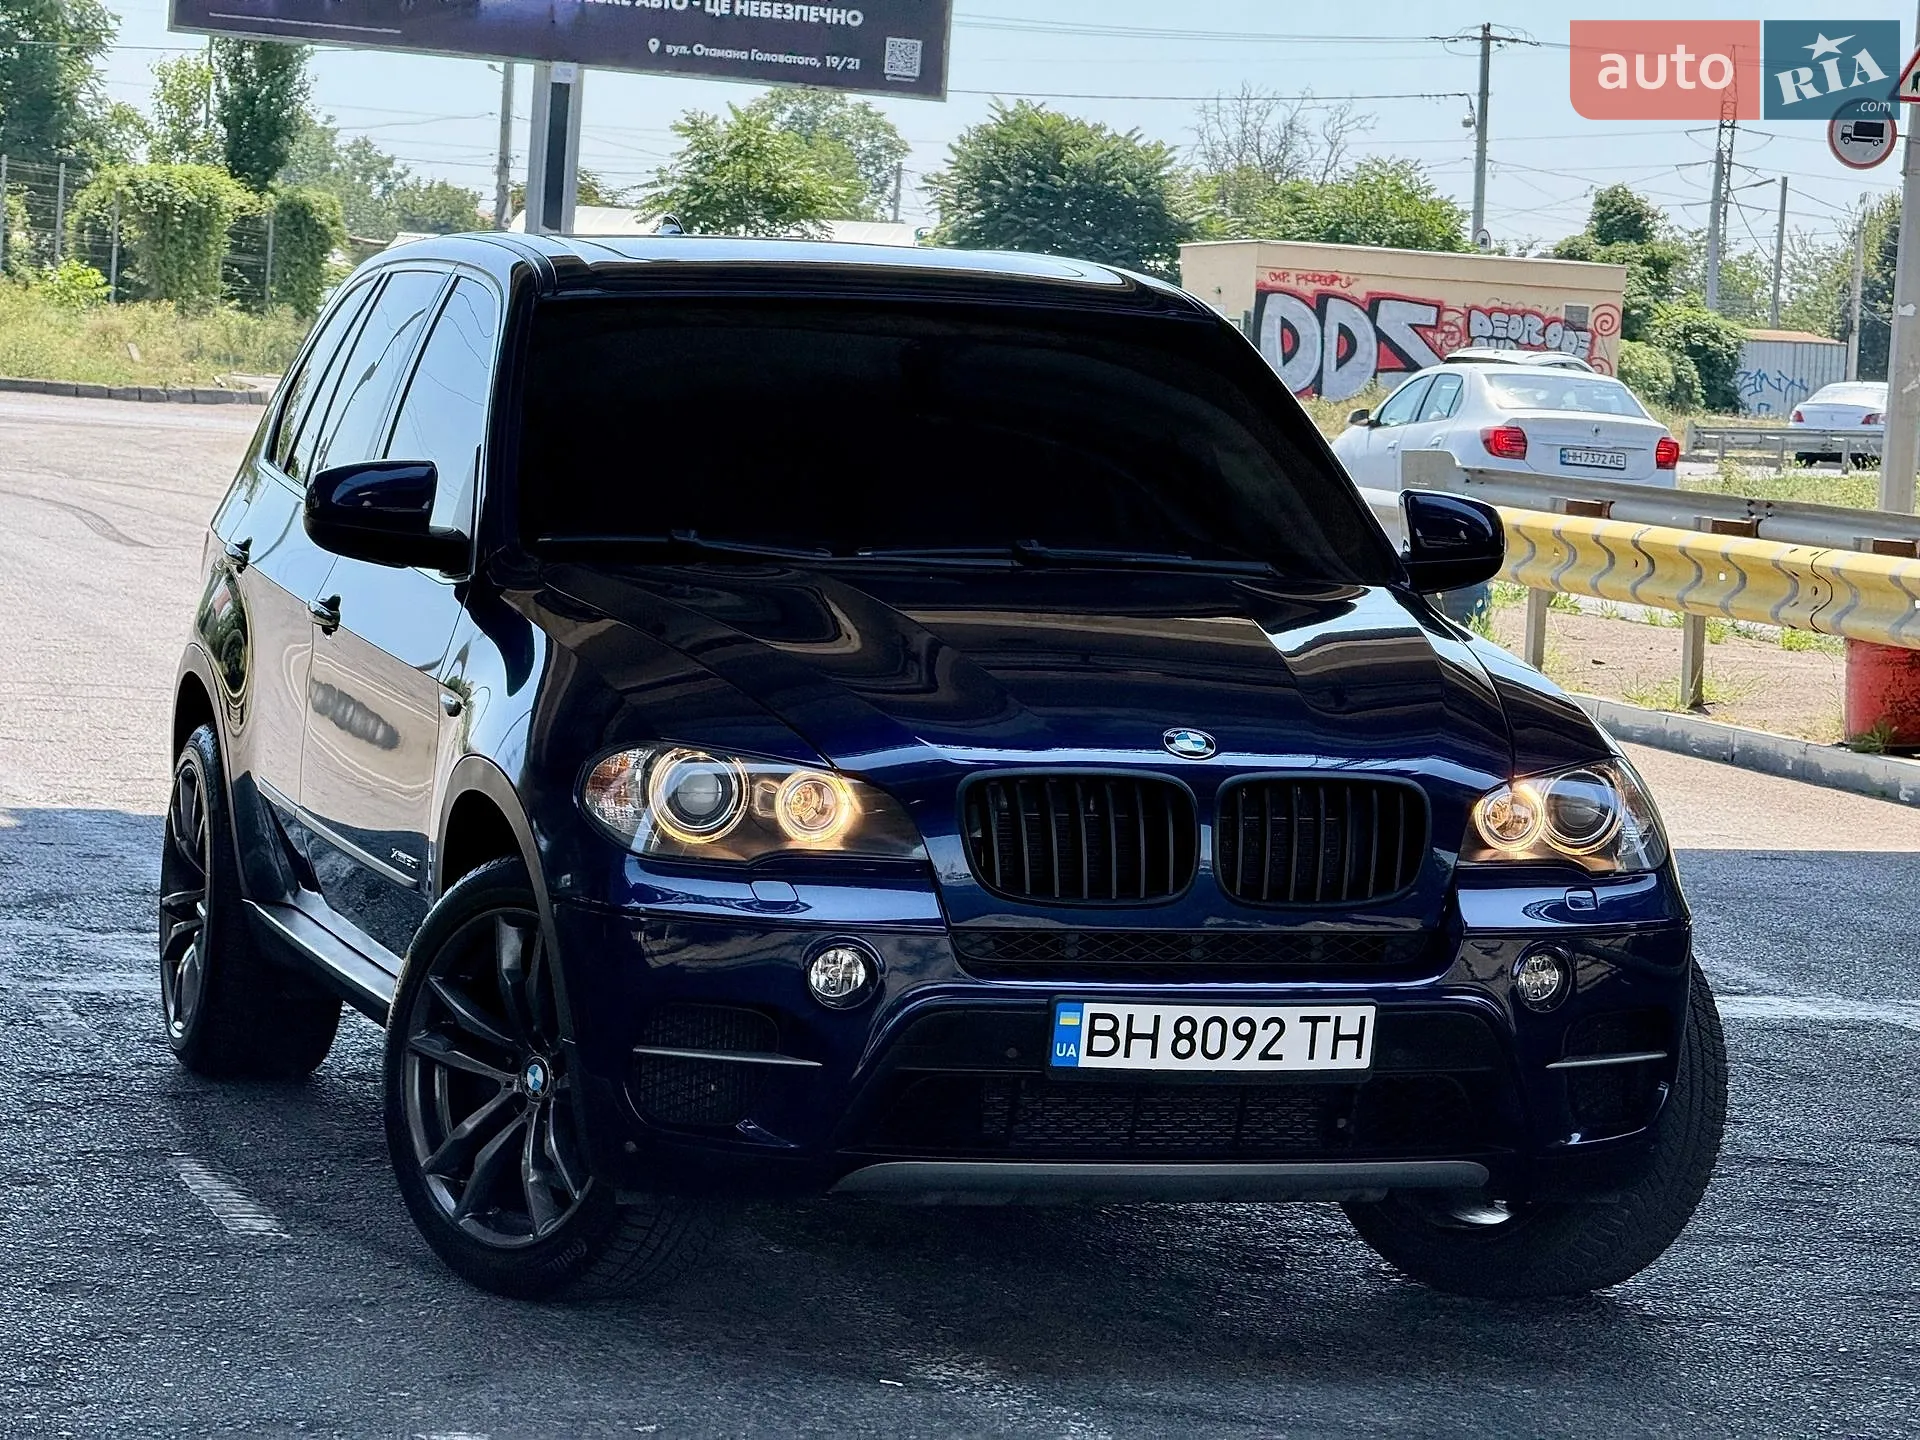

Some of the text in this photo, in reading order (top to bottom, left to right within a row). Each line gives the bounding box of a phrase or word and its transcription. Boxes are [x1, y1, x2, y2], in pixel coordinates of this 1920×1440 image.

[704, 0, 731, 16] ЦЕ
[734, 1, 864, 27] НЕБЕЗПЕЧНО
[665, 43, 860, 71] вул. Отамана Головатого, 19/21
[1584, 453, 1607, 464] 7372
[1609, 455, 1624, 465] AE
[1056, 1043, 1077, 1057] UA
[1086, 1012, 1367, 1061] BH 8092 TH
